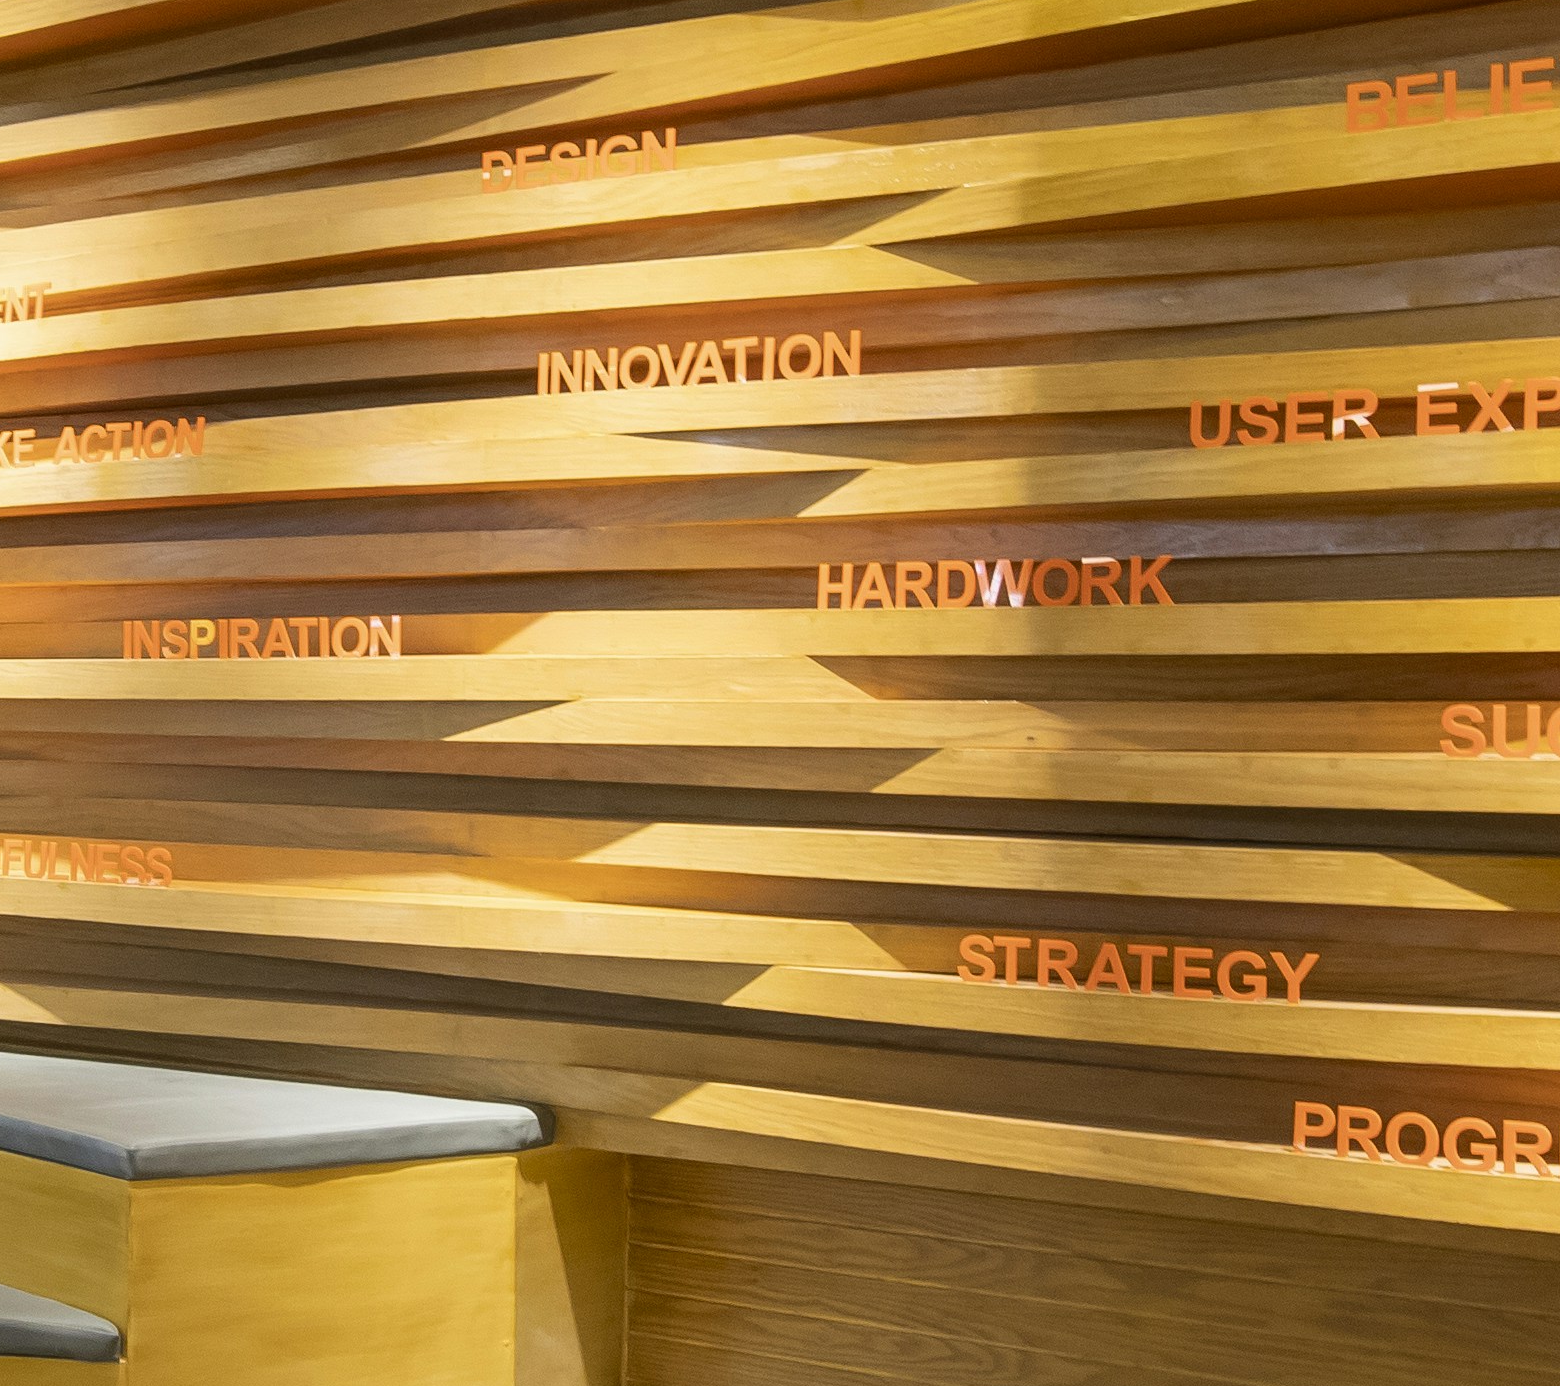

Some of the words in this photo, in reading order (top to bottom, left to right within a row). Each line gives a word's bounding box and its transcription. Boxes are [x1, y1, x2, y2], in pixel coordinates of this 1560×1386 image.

[482, 128, 678, 194] DESIGN
[537, 329, 862, 396] INNOVATION
[53, 417, 206, 466] ACTION
[1189, 387, 1380, 449] USER
[816, 556, 1174, 611] HARDWORK
[122, 616, 403, 660] INSPIRATION
[958, 935, 1320, 1005] STRATEGY
